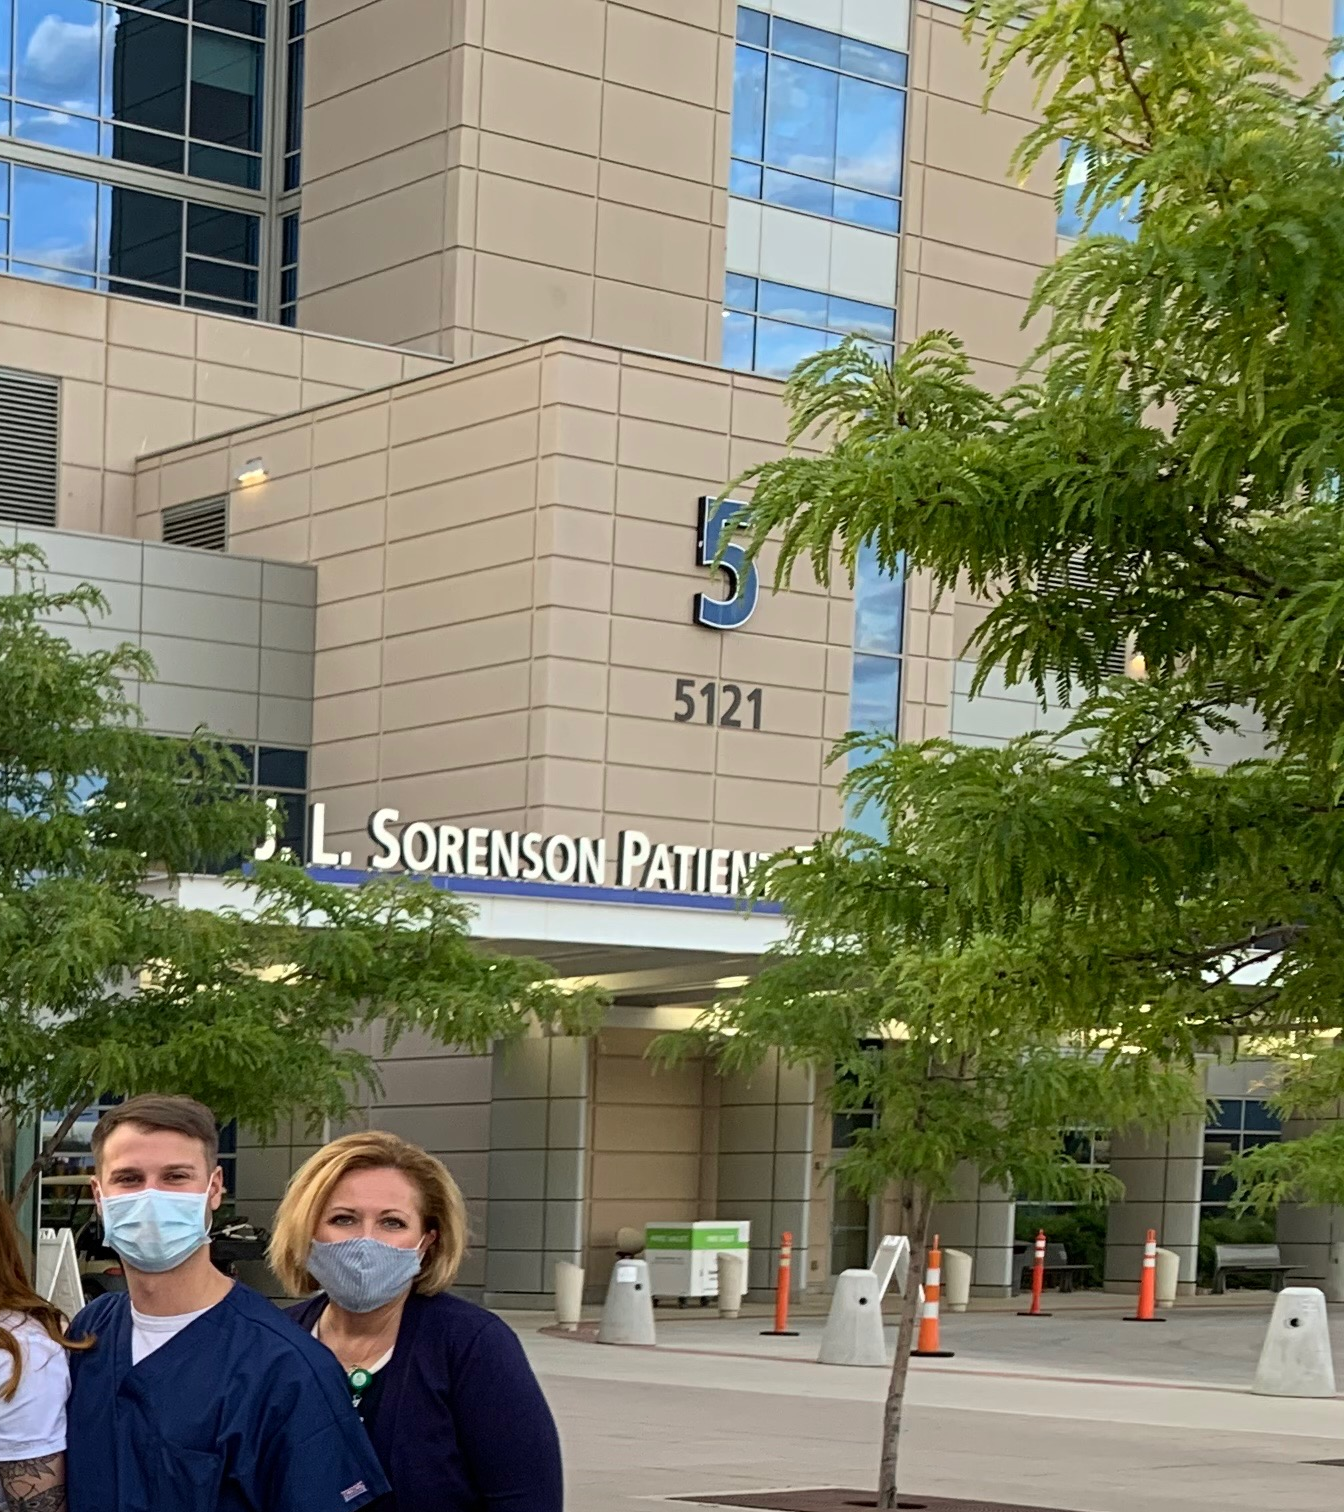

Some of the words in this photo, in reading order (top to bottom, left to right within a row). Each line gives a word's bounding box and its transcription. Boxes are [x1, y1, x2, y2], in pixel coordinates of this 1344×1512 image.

[695, 496, 759, 630] 5
[674, 678, 763, 730] 5121
[312, 802, 352, 866] L.
[370, 808, 606, 885] SORENSON
